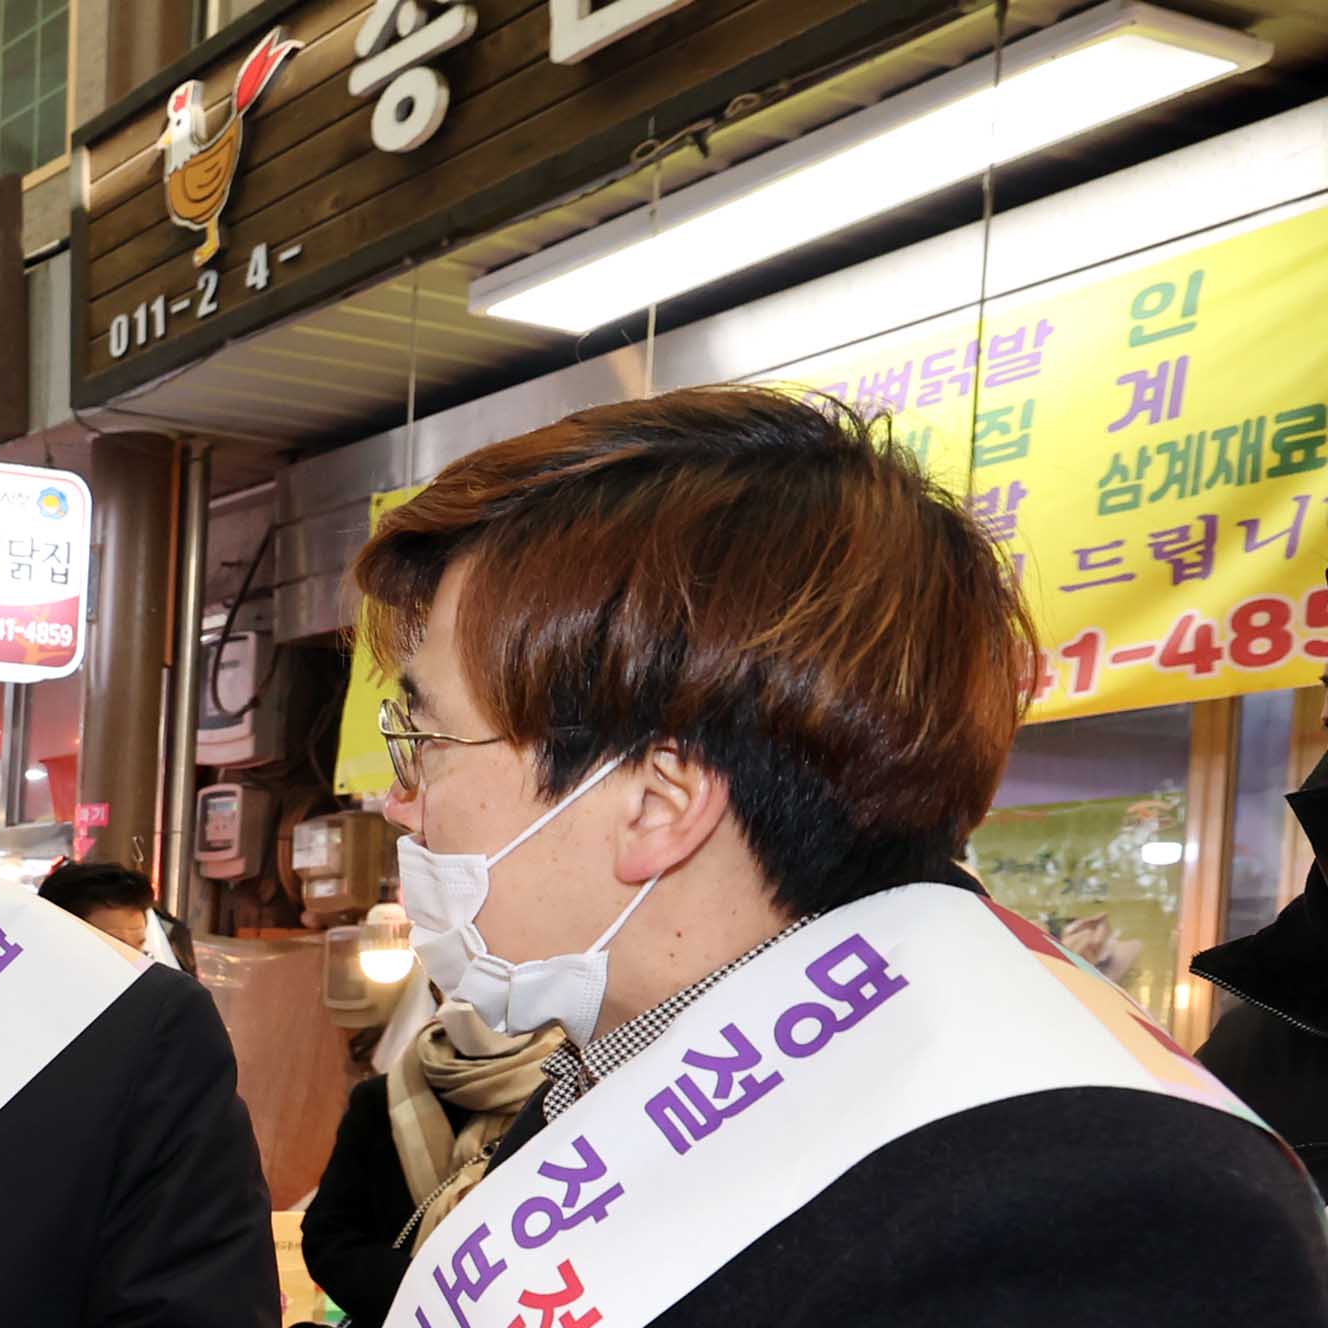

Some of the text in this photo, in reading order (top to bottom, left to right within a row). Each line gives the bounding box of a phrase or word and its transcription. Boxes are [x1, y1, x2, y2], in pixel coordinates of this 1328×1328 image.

[109, 267, 219, 360] 011-2
[1127, 269, 1206, 349] 인
[1107, 354, 1192, 434] 계
[1096, 401, 1328, 517] 삼계재료
[1058, 493, 1328, 593] 드립니
[643, 933, 909, 1155] 명절
